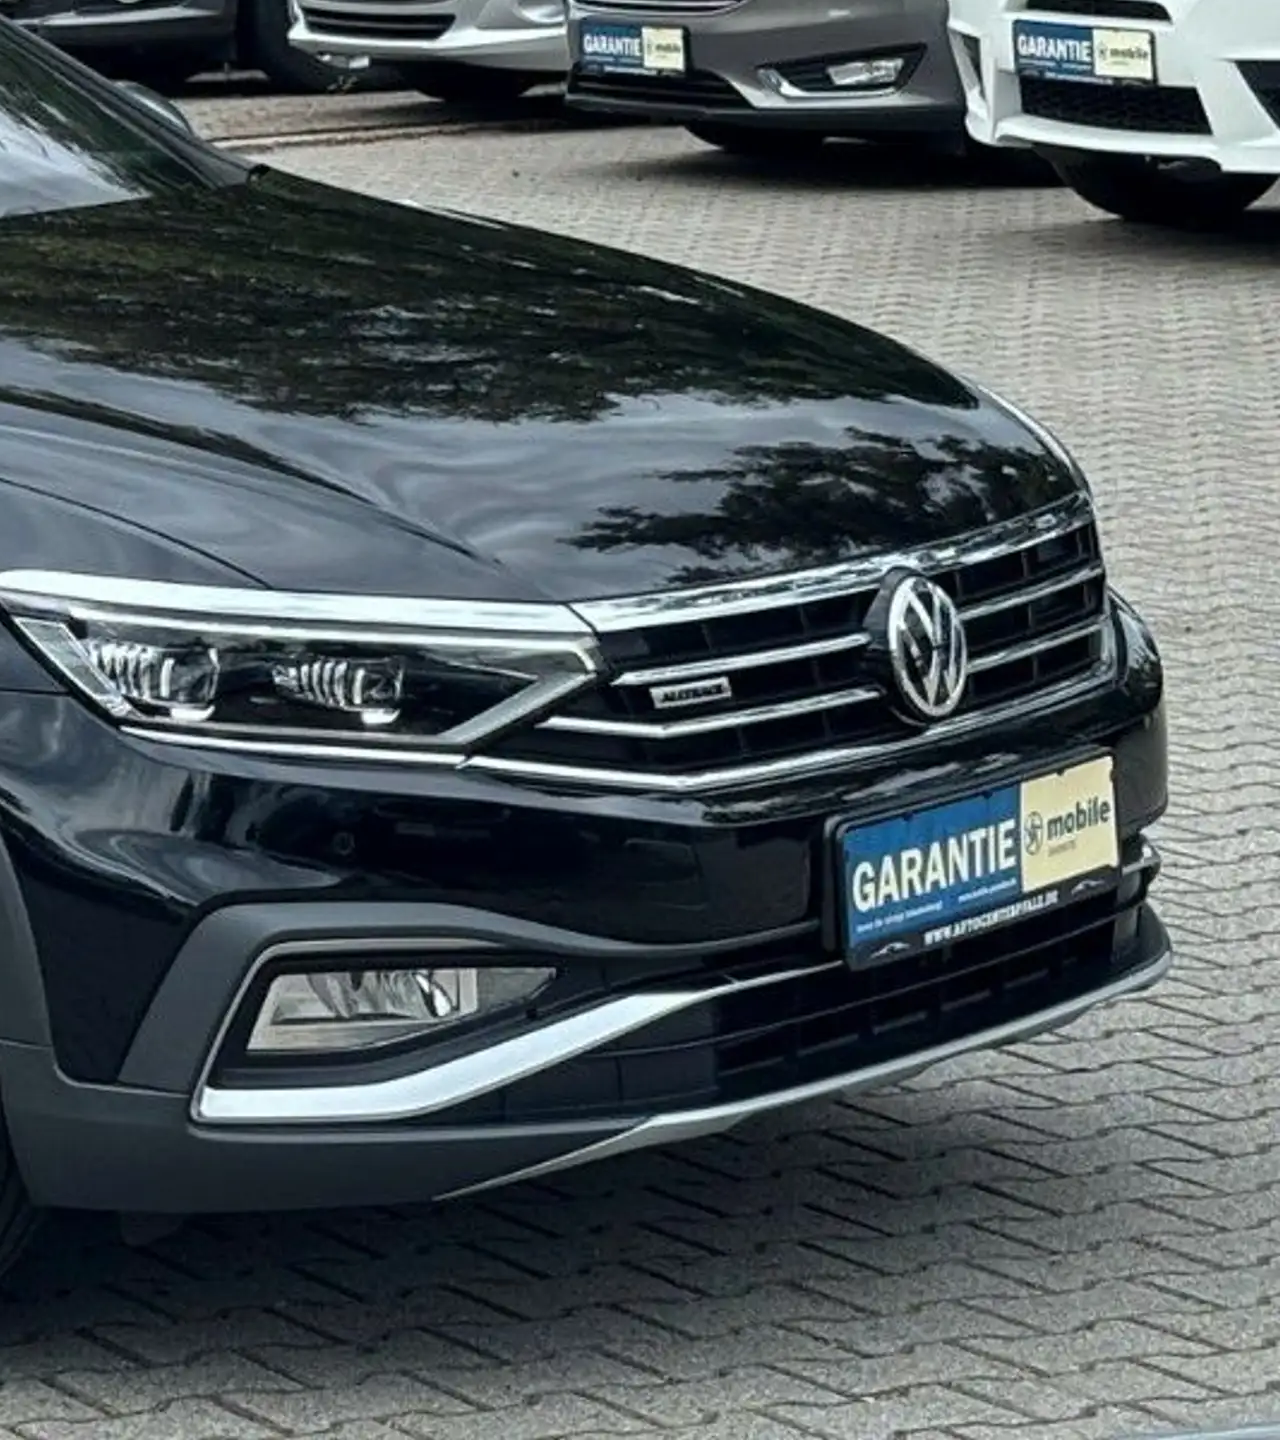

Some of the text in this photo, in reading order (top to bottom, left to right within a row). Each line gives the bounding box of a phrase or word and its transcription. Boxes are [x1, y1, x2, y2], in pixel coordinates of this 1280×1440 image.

[583, 33, 642, 56] GARANTIE
[1017, 33, 1092, 62] GARANTIE
[852, 817, 1017, 912] GARANTIE
[1046, 796, 1111, 840] mobile
